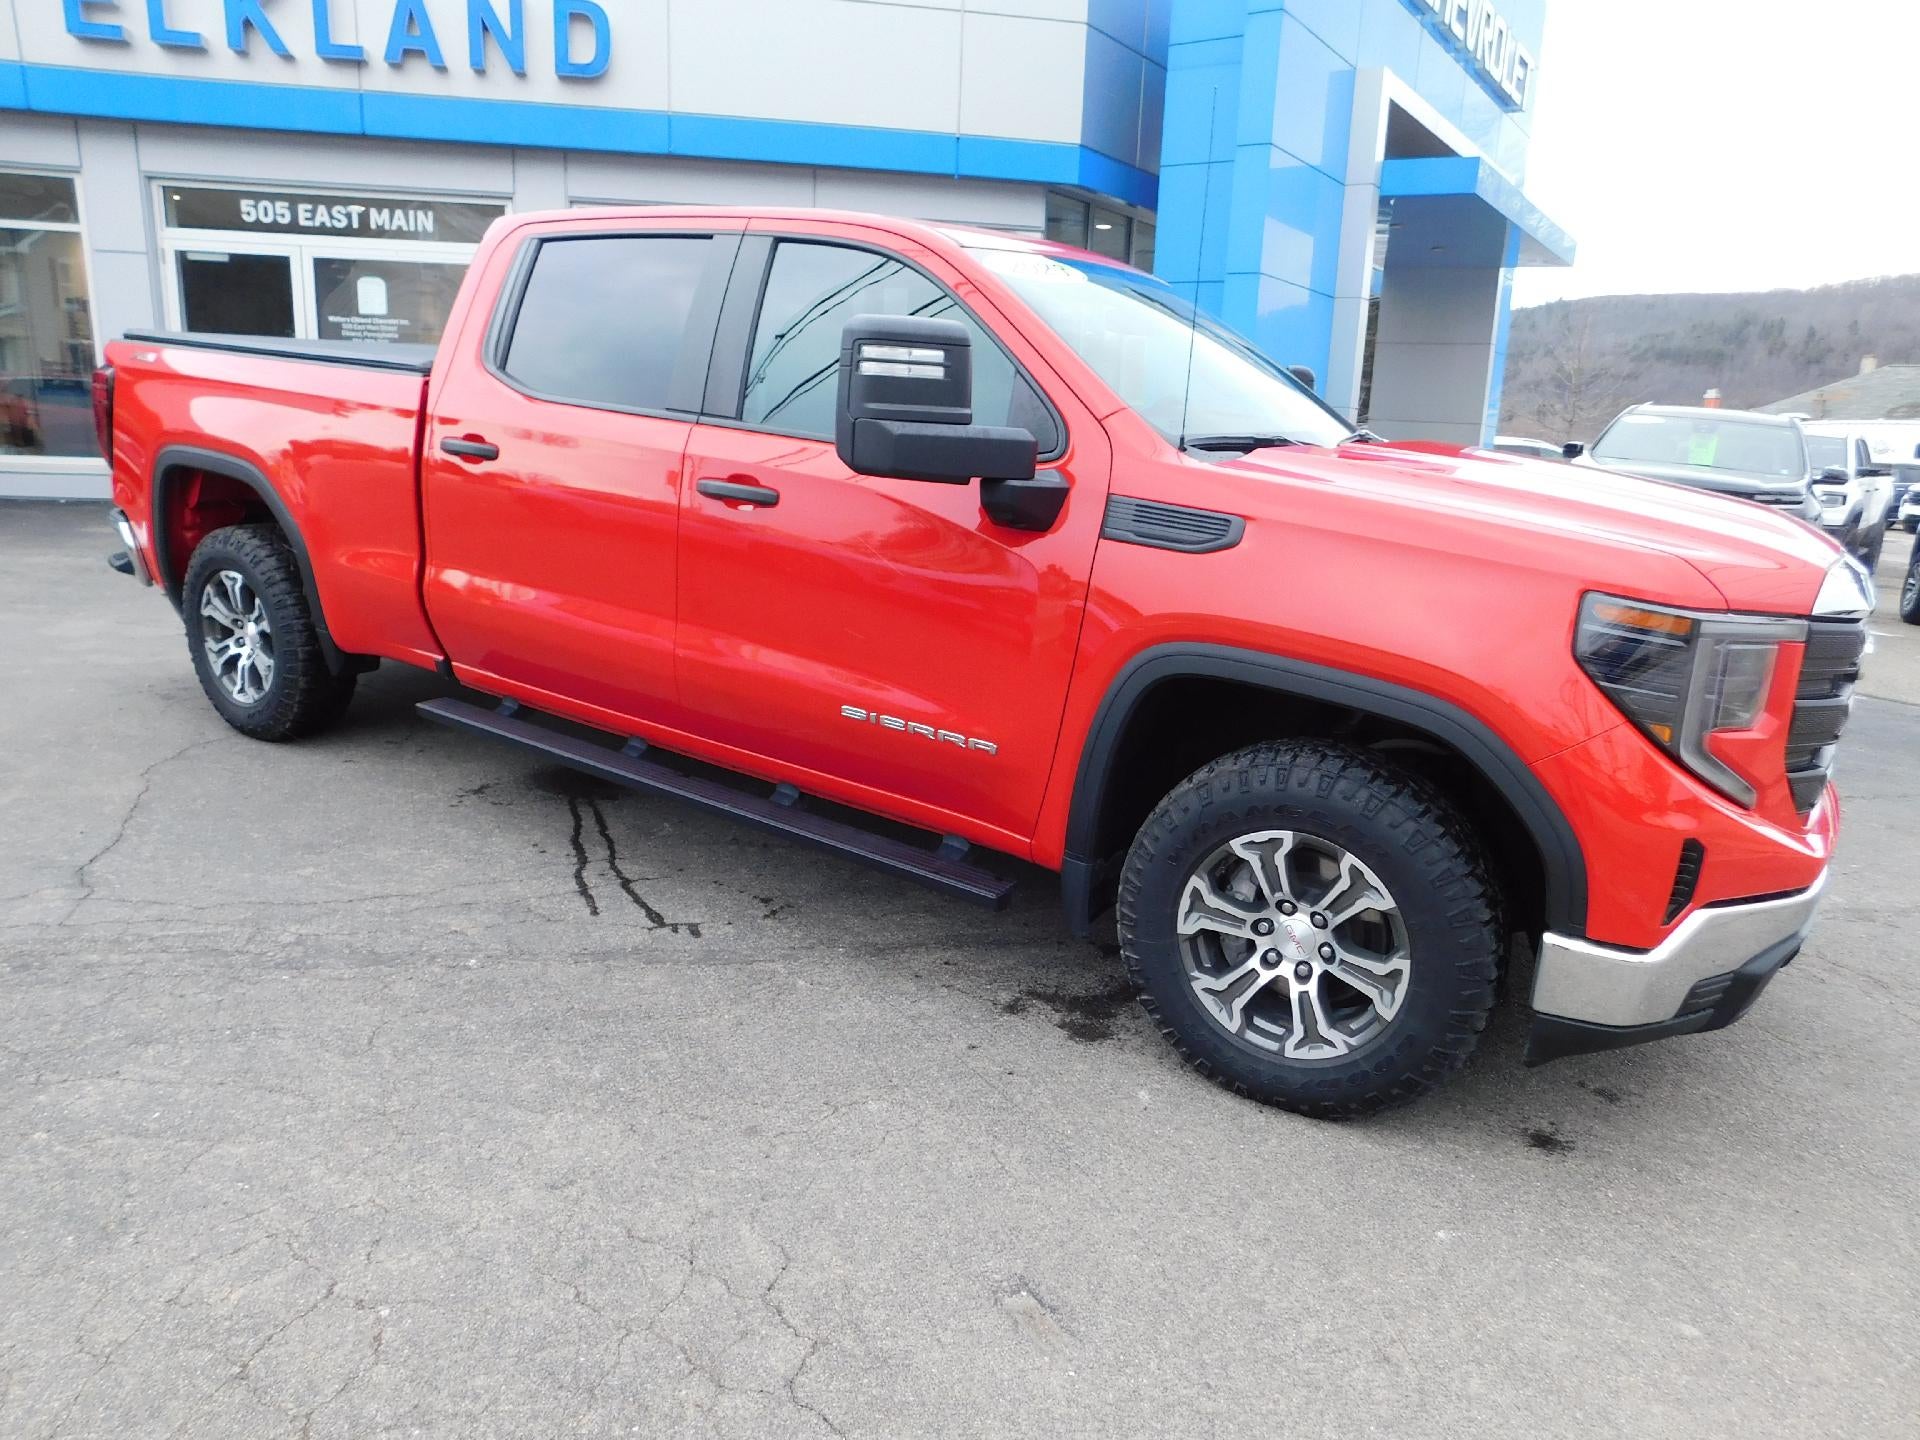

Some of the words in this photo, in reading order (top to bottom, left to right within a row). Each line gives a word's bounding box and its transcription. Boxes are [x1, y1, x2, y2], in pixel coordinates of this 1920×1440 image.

[1423, 0, 1536, 112] EVROLET
[239, 198, 292, 224] 505
[297, 203, 362, 229] EAST
[369, 207, 435, 233] MAIN
[840, 704, 999, 756] SIERRA
[1285, 924, 1306, 955] GMC
